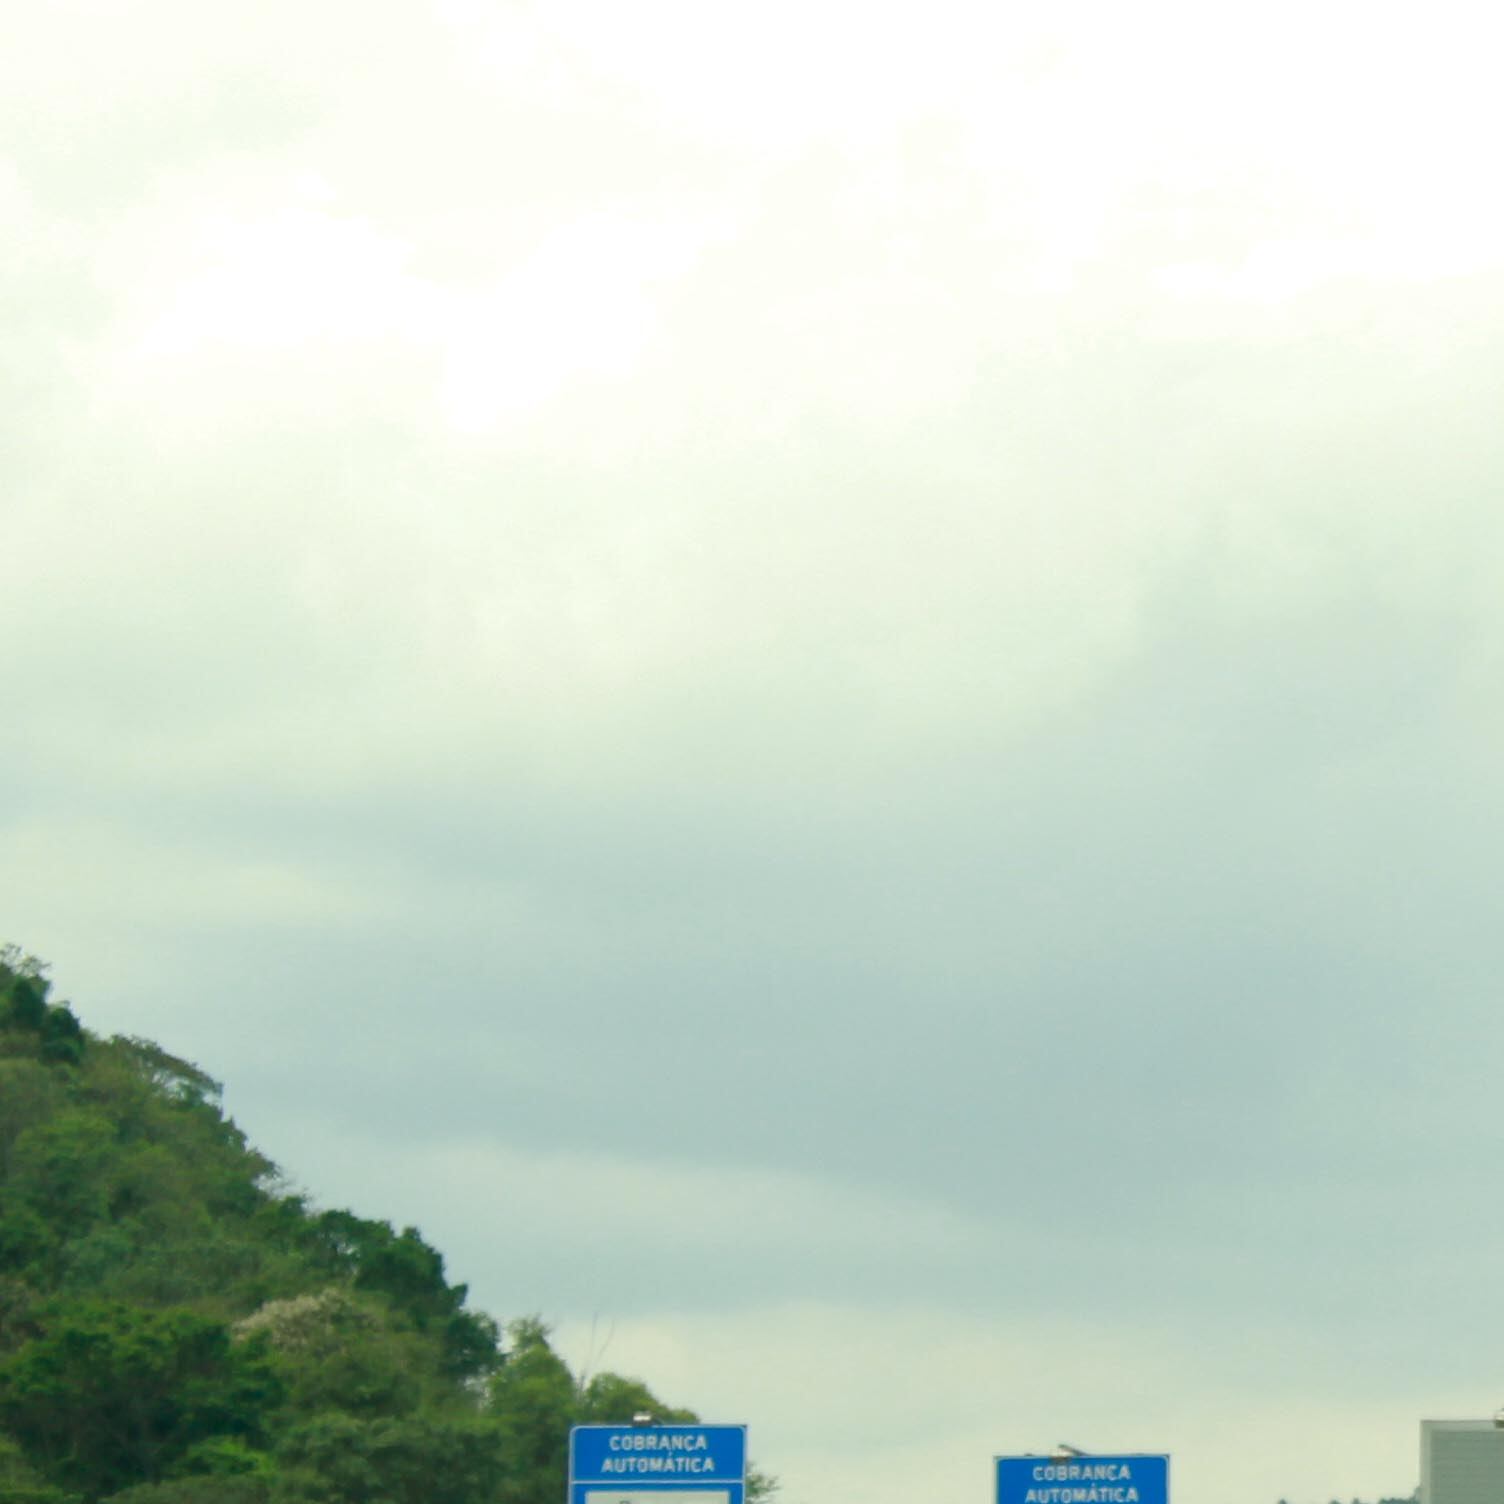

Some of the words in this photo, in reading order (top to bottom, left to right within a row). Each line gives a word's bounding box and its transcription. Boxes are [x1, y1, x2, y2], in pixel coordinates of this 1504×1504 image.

[609, 1435, 707, 1452] COBRANÇA
[601, 1451, 715, 1473] AUTOMÁTICA
[1032, 1464, 1131, 1482] COBRANÇA
[1025, 1482, 1139, 1504] AUTOMÁTICA
